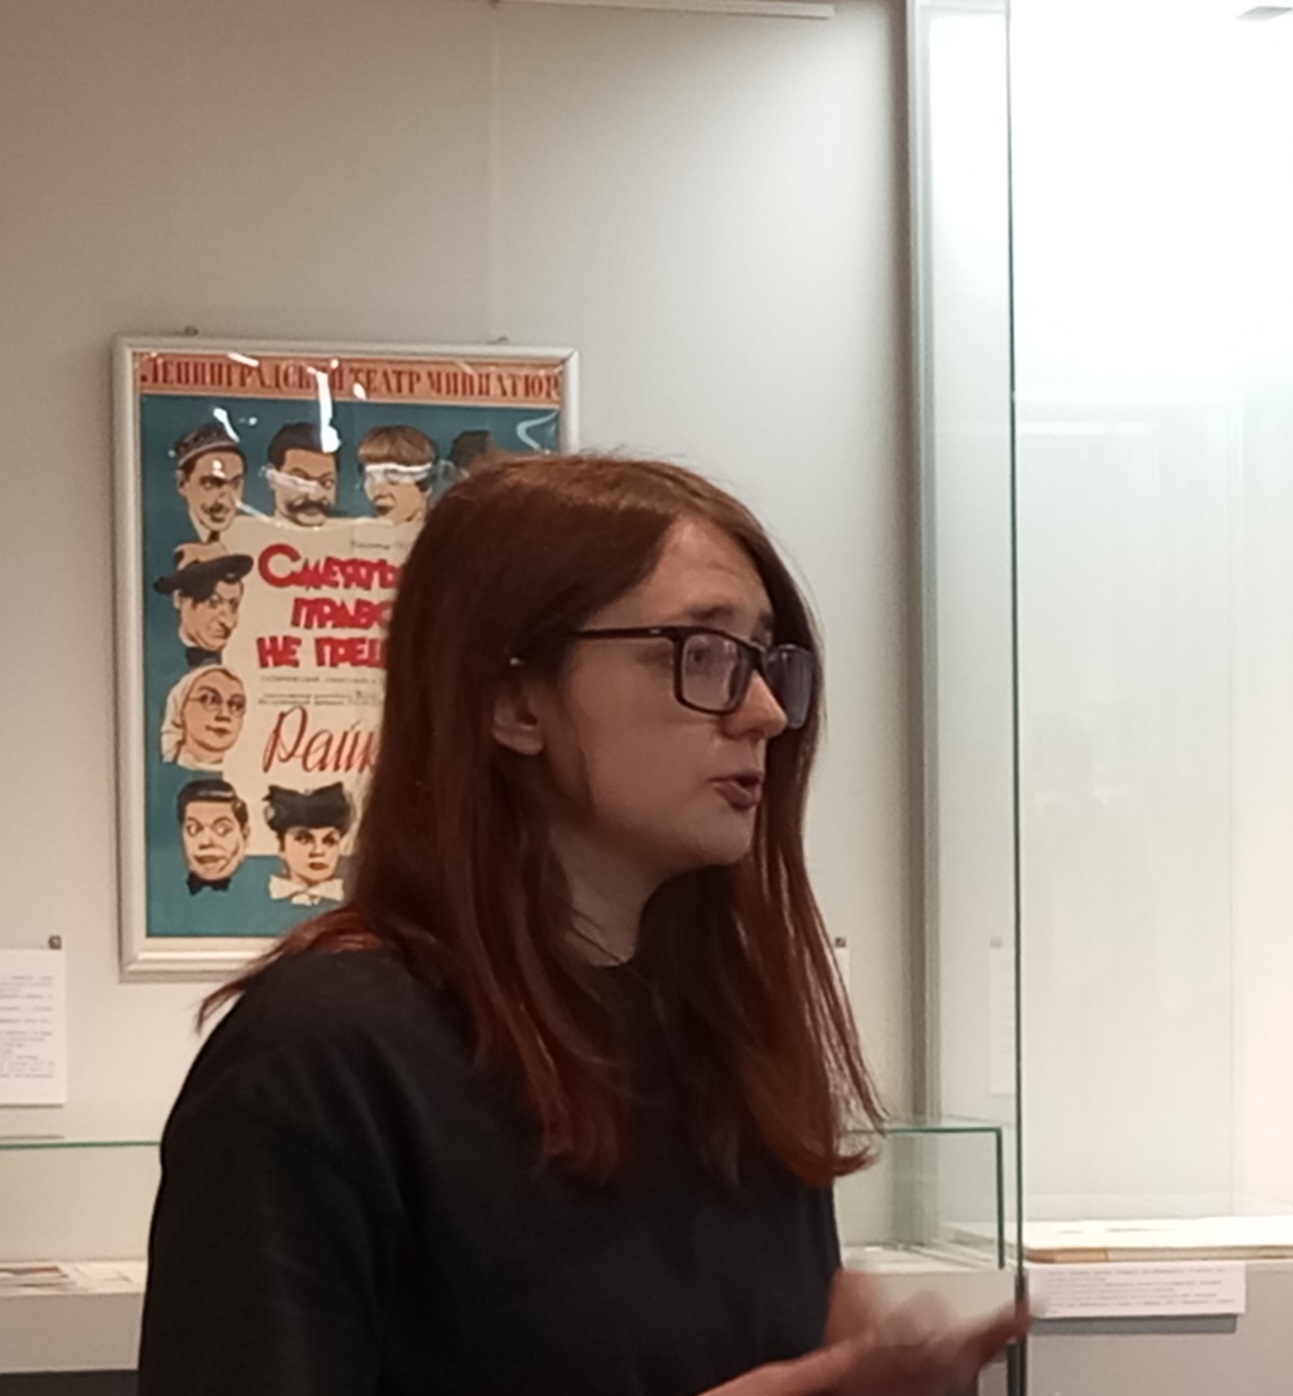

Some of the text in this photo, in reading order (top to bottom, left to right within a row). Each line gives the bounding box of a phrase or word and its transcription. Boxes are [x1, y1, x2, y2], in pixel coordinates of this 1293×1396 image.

[140, 358, 562, 399] ЛЕНИНГРАДСКЙ ТЕАТР МИНИАТЮР
[256, 635, 301, 668] НЕ
